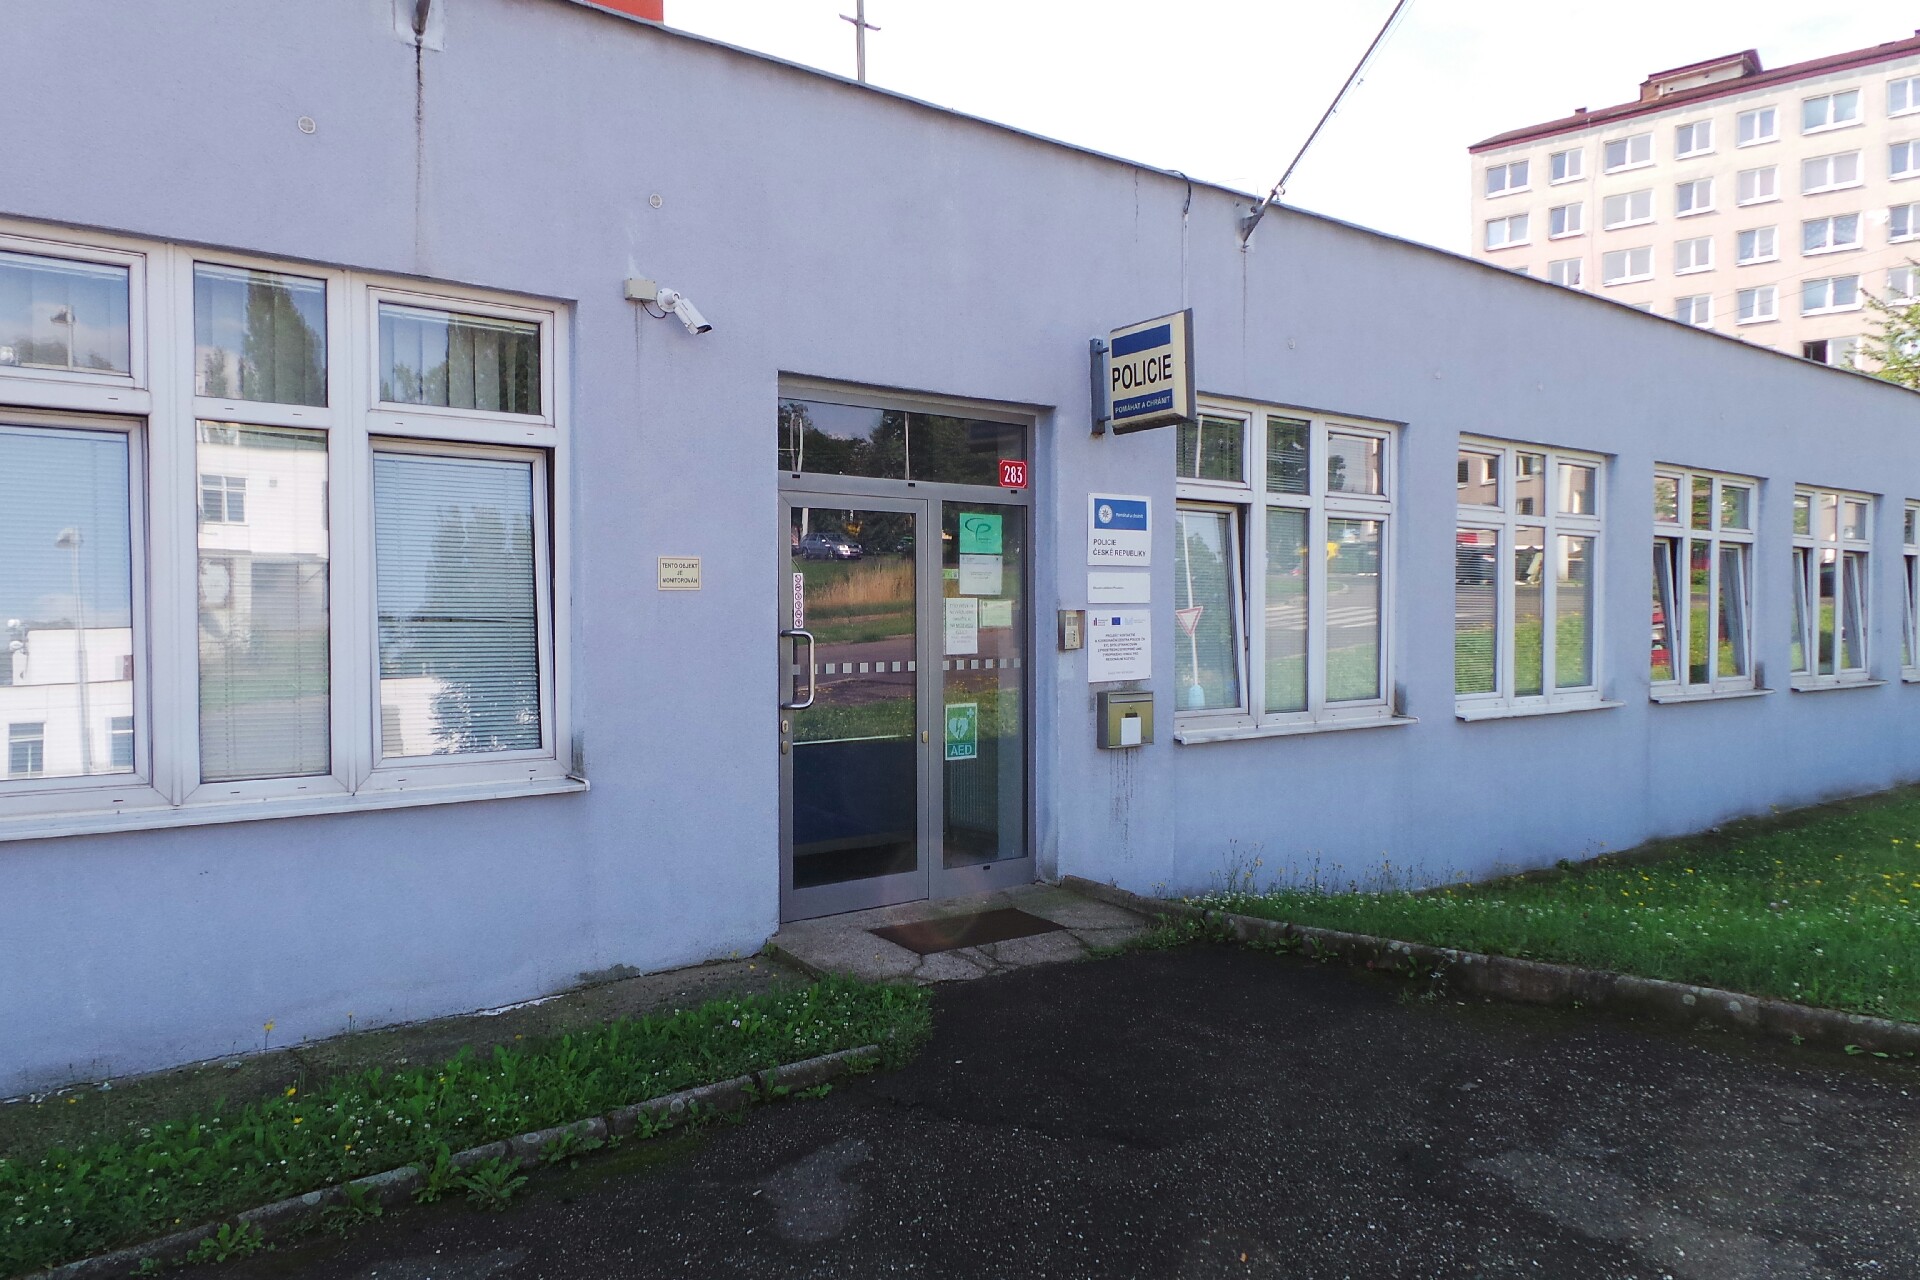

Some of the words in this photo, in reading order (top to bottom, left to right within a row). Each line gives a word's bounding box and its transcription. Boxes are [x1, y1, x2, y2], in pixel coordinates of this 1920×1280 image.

[1112, 354, 1172, 391] POLICIE
[1004, 465, 1023, 483] 283
[1093, 548, 1113, 556] ČESKÉ
[951, 745, 972, 756] AED
